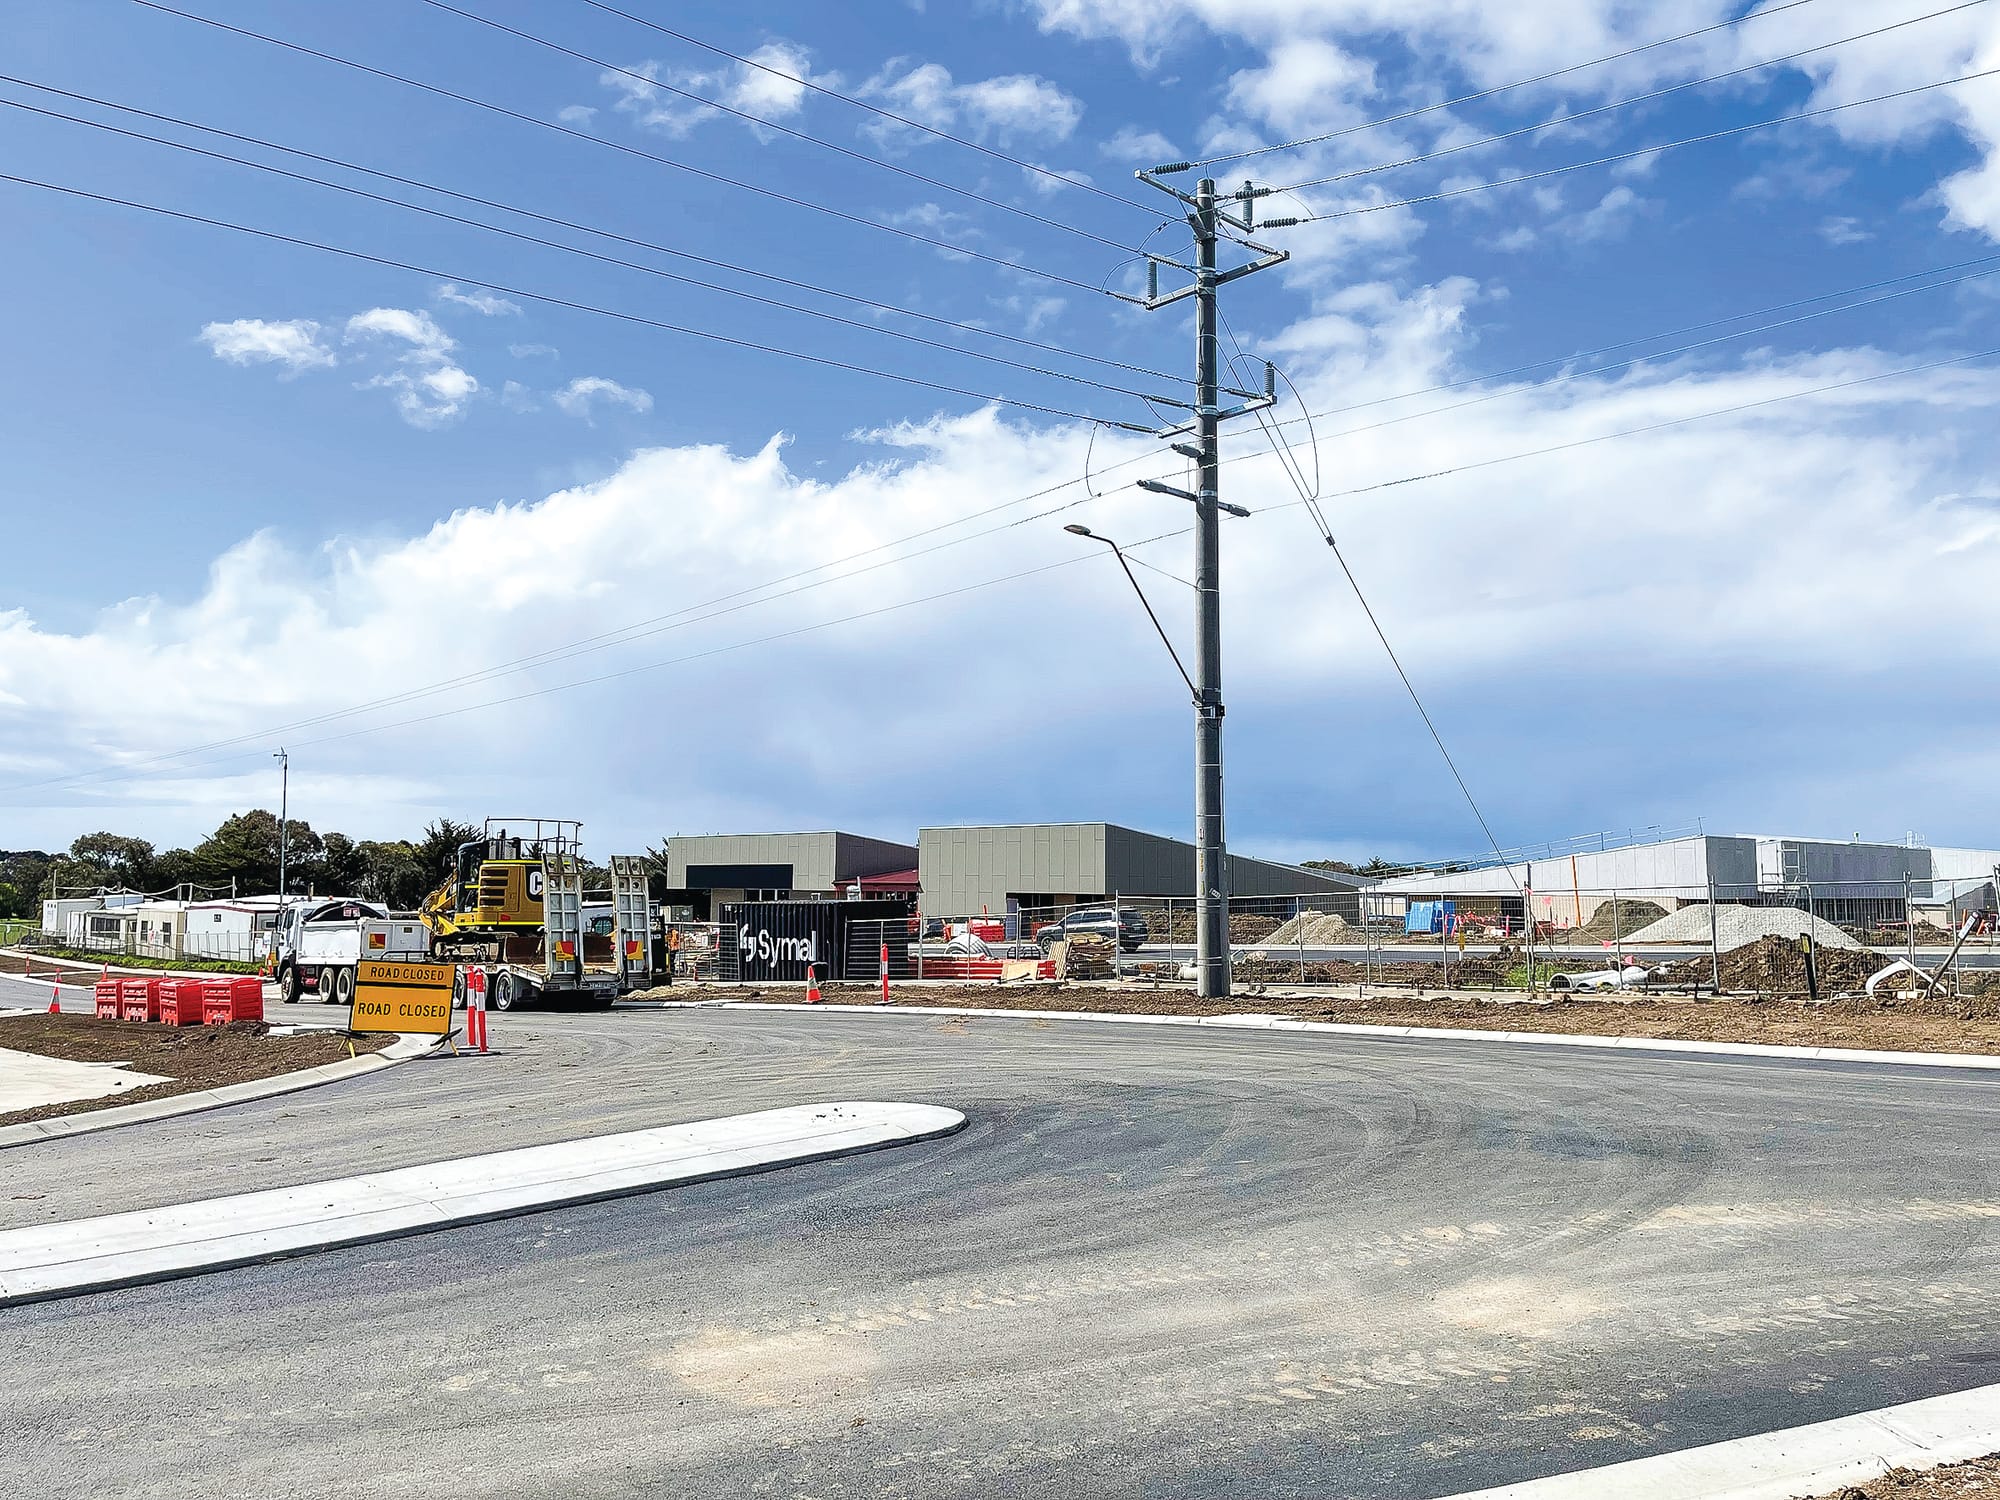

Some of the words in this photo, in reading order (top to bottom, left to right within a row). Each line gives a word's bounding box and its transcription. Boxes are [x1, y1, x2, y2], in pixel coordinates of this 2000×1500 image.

[758, 929, 817, 968] Symal
[370, 967, 400, 978] ROAD
[402, 968, 445, 980] CLOSED
[357, 1002, 391, 1015] ROAD
[399, 1003, 446, 1017] CLOSED
